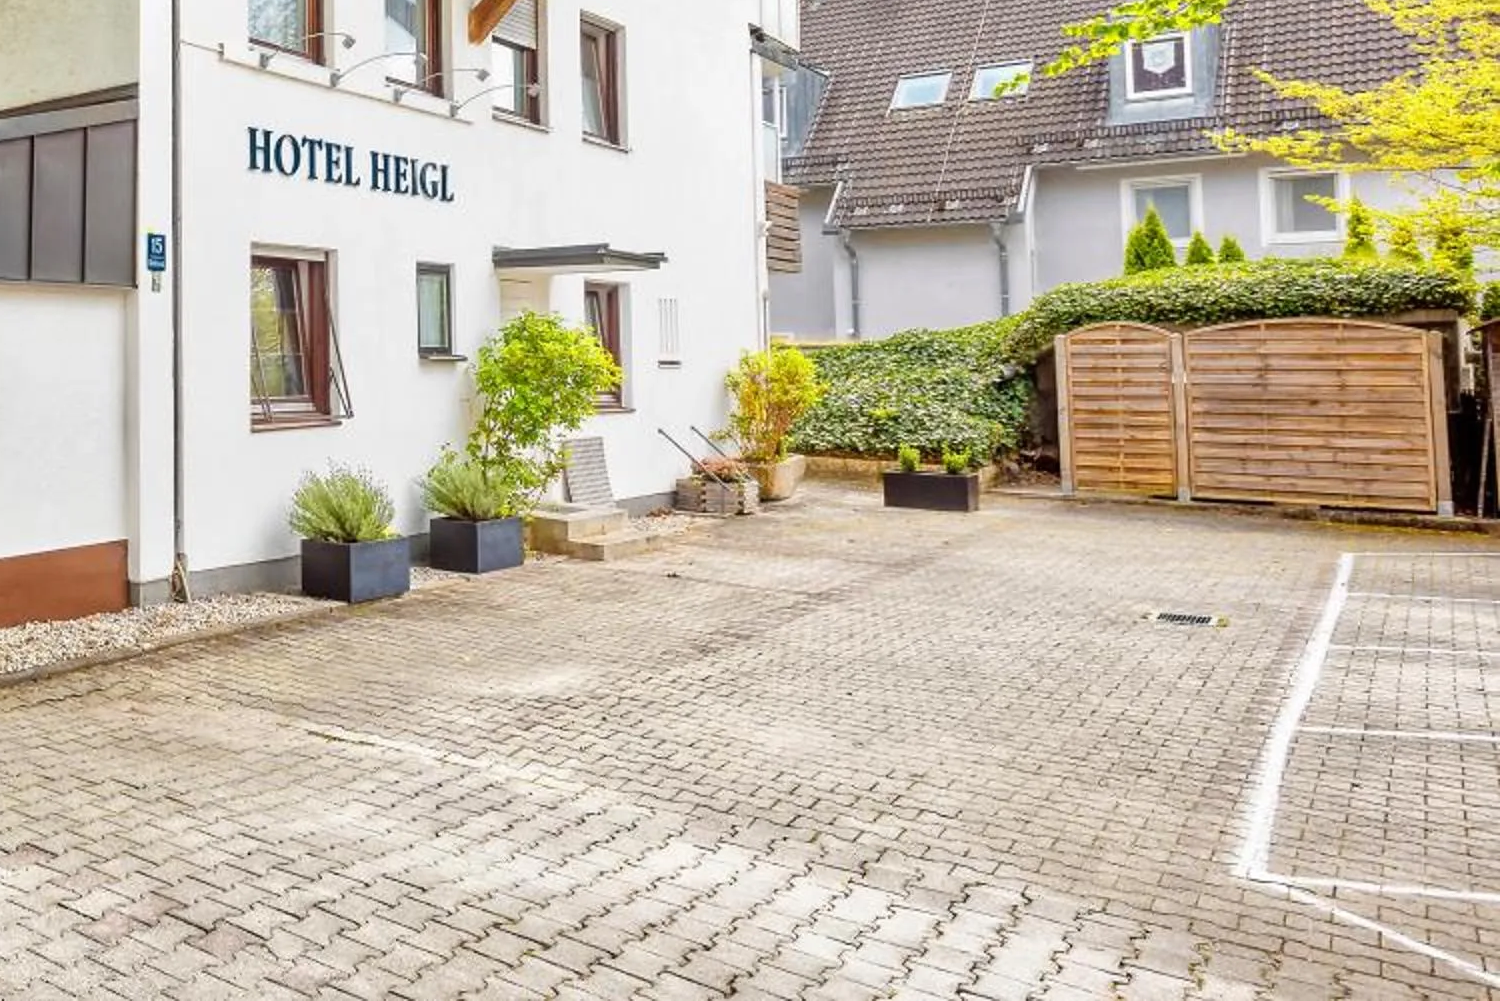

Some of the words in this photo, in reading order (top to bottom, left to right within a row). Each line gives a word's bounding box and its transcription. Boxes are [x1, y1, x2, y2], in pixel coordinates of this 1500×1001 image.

[247, 126, 361, 187] HOTEL
[370, 150, 455, 202] HEIGL
[151, 237, 163, 254] 15
